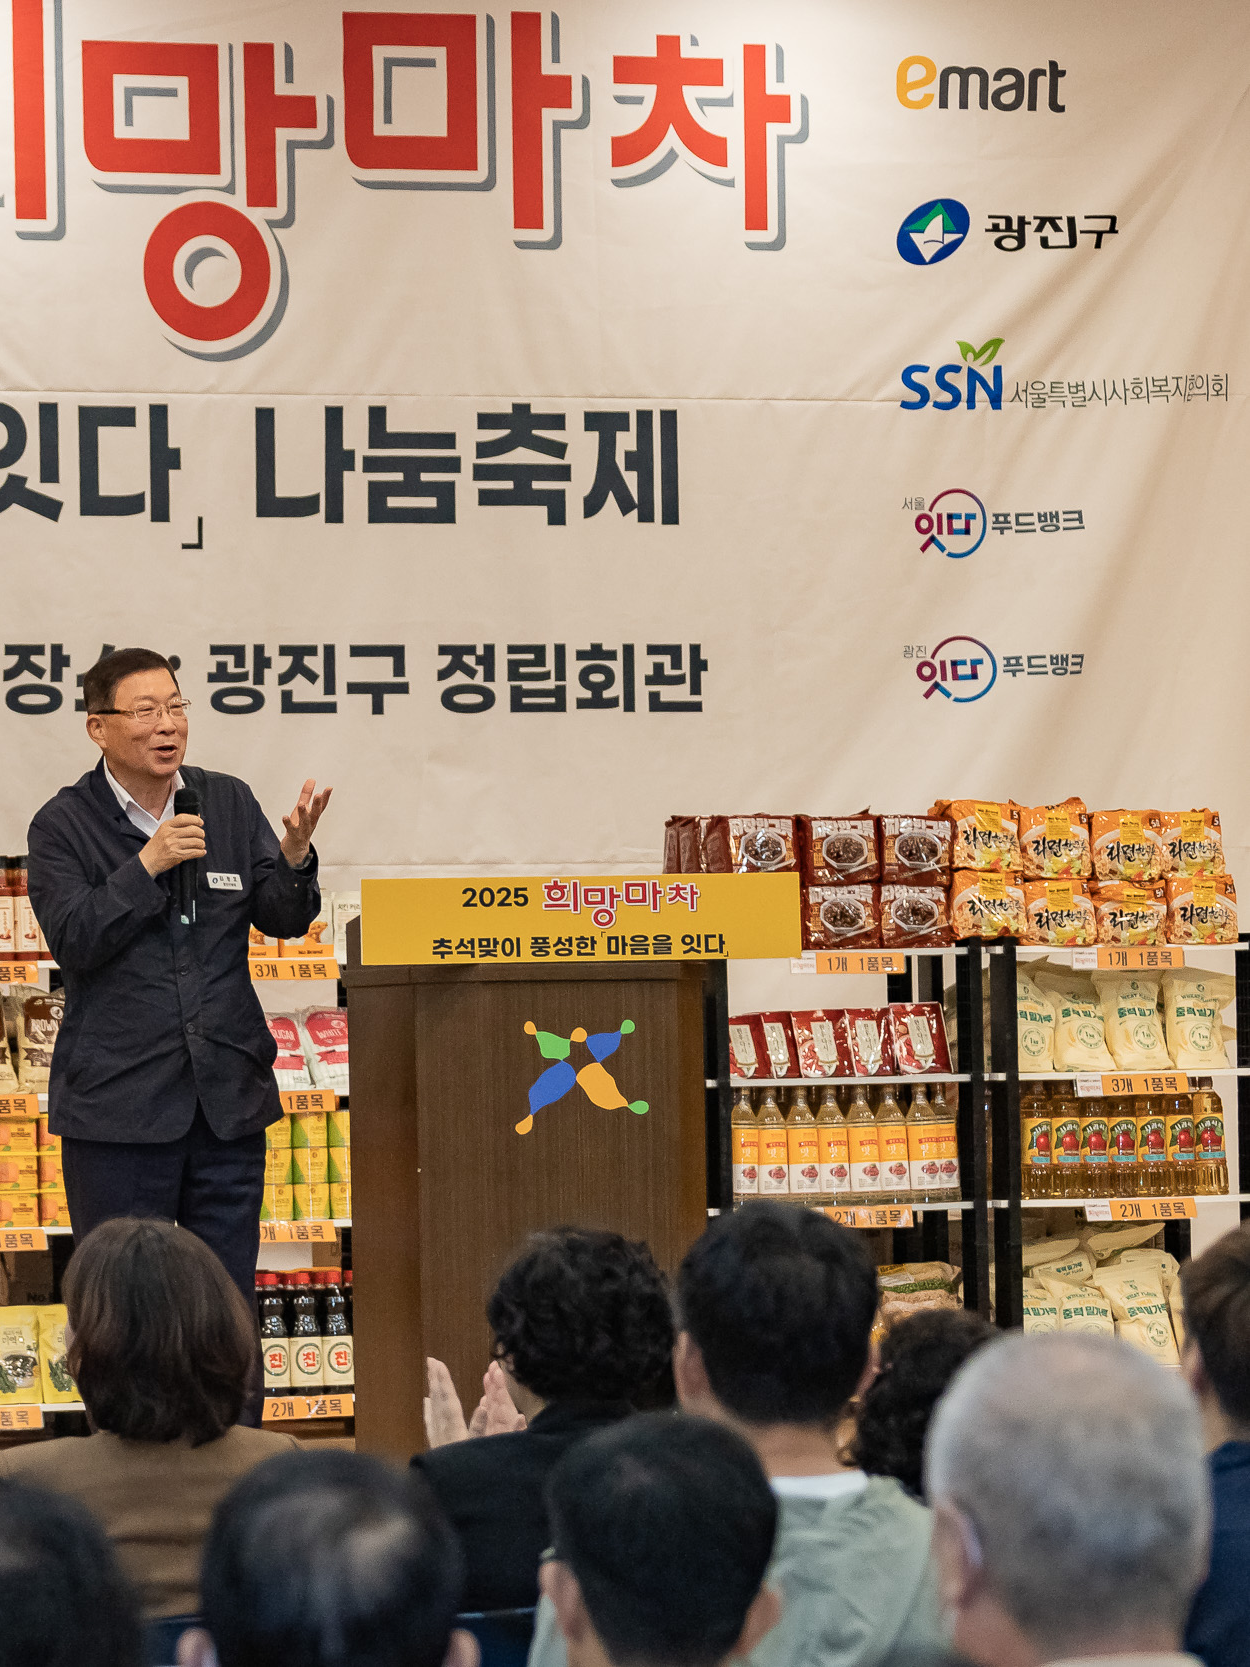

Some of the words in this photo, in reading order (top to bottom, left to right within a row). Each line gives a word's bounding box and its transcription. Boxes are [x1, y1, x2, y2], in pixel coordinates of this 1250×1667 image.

[896, 55, 1066, 113] emart
[985, 214, 1119, 252] 광진구
[900, 364, 1003, 411] SSN
[255, 402, 681, 526] 나눔축제
[902, 496, 926, 511] 서울
[991, 509, 1086, 535] 푸드뱅크
[915, 512, 977, 554] 잇다
[903, 645, 927, 659] 광진
[1002, 653, 1085, 678] 푸드뱅크
[206, 643, 410, 716] 광진구
[436, 642, 709, 714] 정립회관
[916, 658, 985, 700] 잇다
[461, 886, 530, 908] 2025
[541, 878, 701, 929] 희망마차
[432, 937, 522, 960] 추석맞이
[530, 936, 598, 958] 풍성한
[827, 957, 848, 972] 1개
[859, 957, 895, 972] 1품목
[1108, 952, 1127, 967] 1개
[1138, 951, 1172, 967] 1품목
[256, 963, 278, 978] 3개
[290, 962, 327, 978] 1품목
[1018, 1009, 1052, 1023] 력밀가루
[31, 1018, 59, 1032] BROWN
[1111, 1079, 1133, 1093] 3개
[1144, 1077, 1178, 1092] 1품목
[288, 1094, 323, 1110] 1품목
[1120, 1204, 1142, 1218] 2개
[1152, 1202, 1186, 1217] 1품목
[262, 1227, 276, 1241] 개
[1062, 1305, 1109, 1320] 중력밀가루
[271, 1402, 294, 1418] 2개
